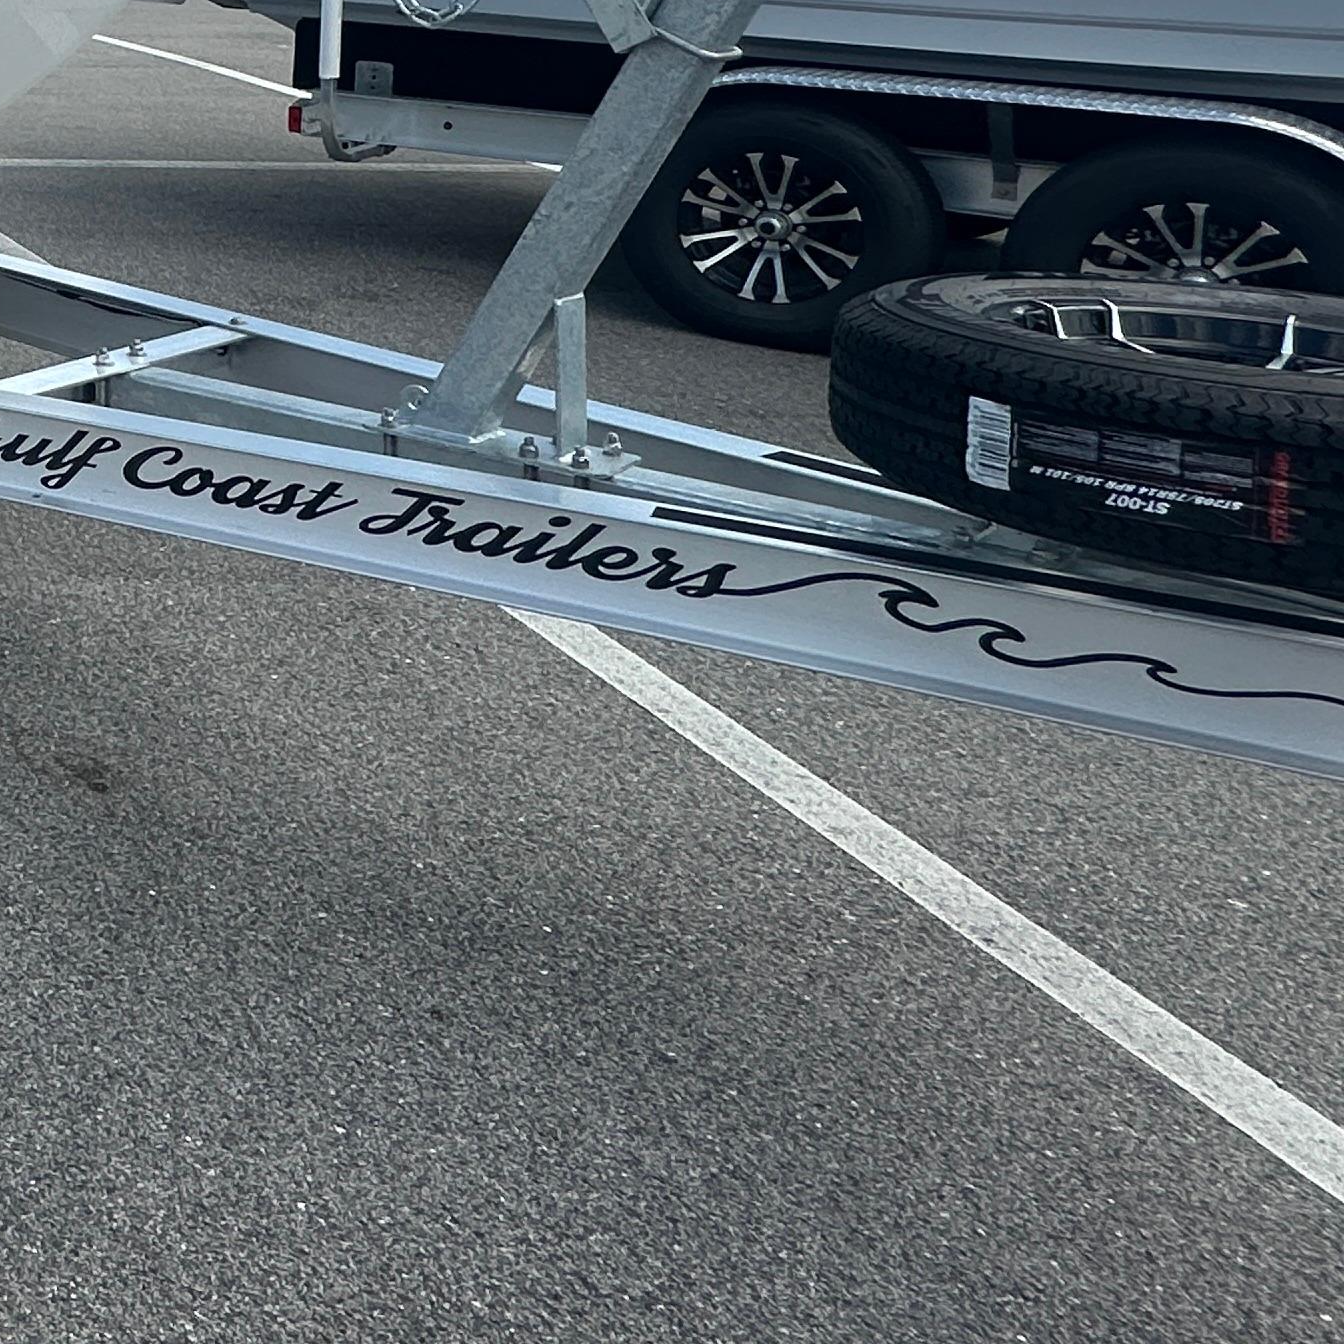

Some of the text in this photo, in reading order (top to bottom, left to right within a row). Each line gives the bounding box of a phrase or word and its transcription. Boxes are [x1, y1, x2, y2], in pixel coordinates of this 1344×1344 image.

[122, 445, 358, 522] Coast
[358, 487, 737, 599] Trailers
[1104, 492, 1172, 516] ST-007
